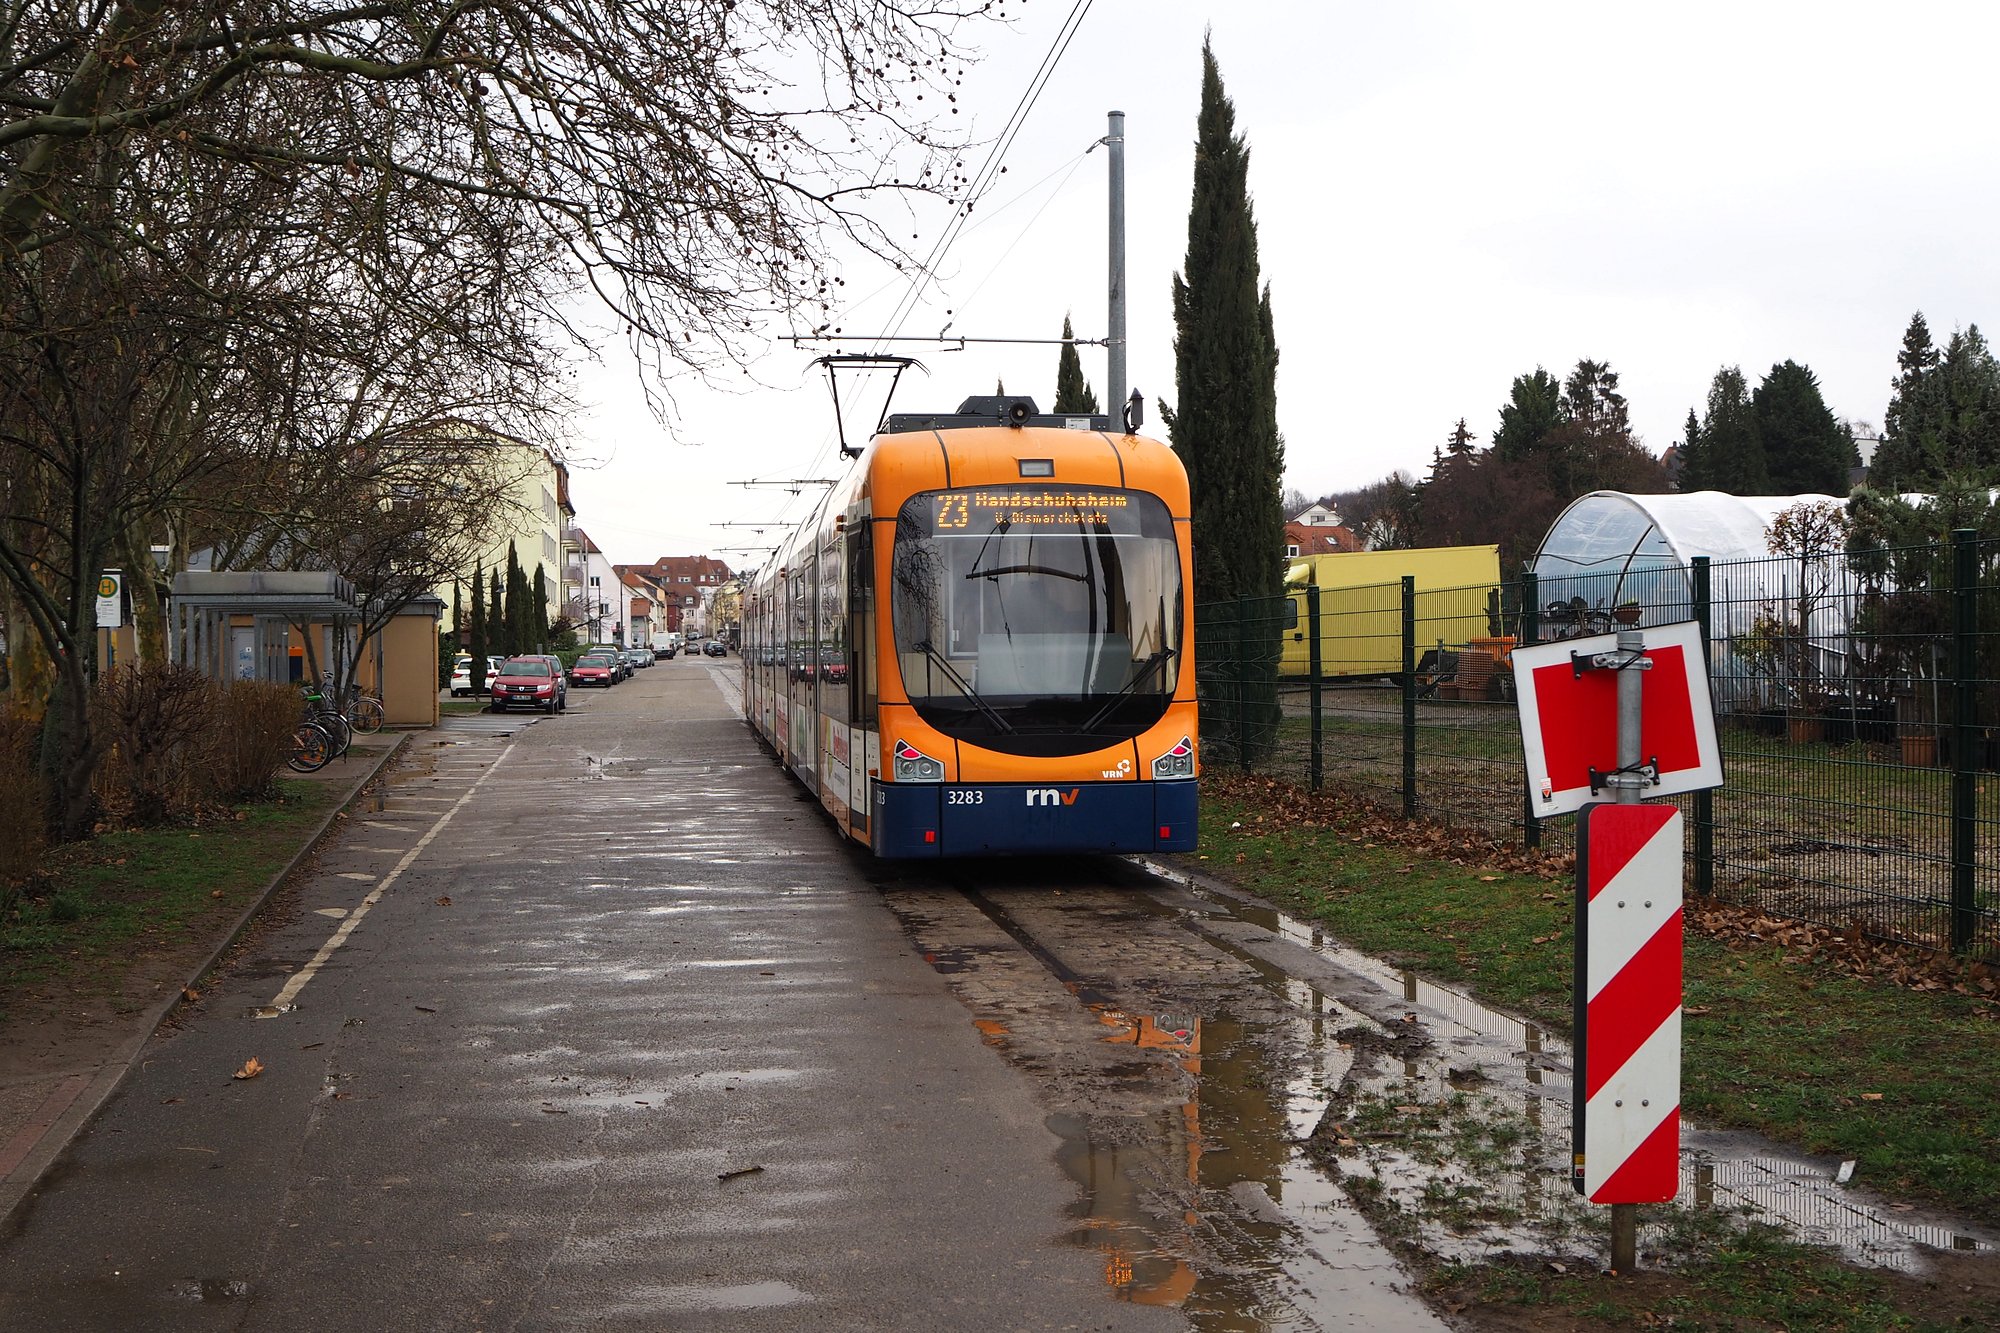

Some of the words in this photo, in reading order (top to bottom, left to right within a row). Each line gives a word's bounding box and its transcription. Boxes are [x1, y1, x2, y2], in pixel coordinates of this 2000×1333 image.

[976, 493, 1127, 507] Handschuhsheim
[938, 495, 968, 527] 23
[1011, 511, 1108, 524] Bismarckplatz
[1102, 770, 1124, 779] VRN
[948, 790, 983, 805] 3283
[1026, 788, 1079, 806] rnv
